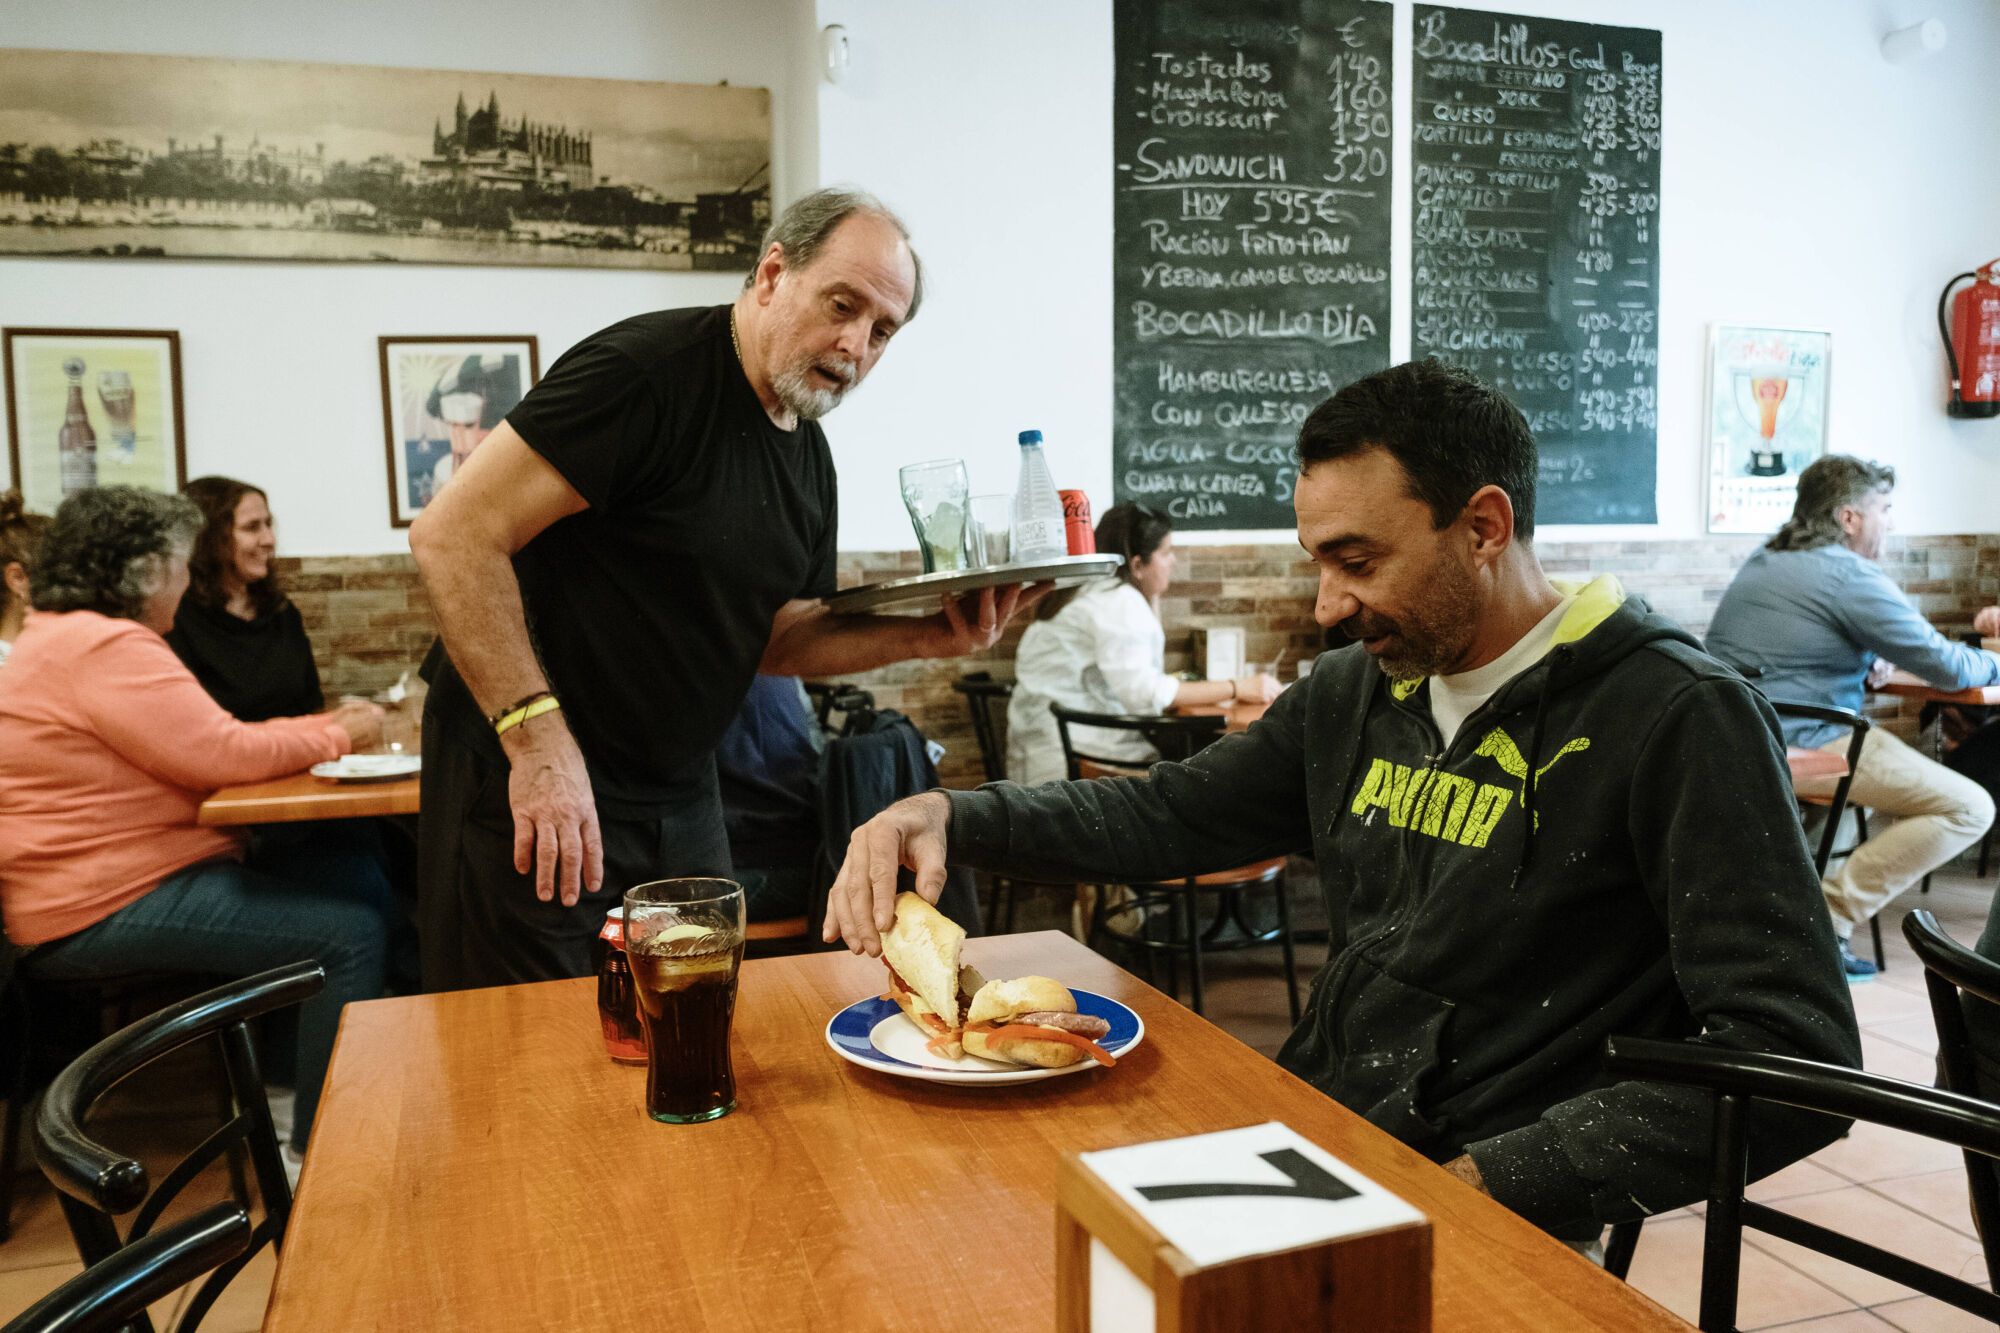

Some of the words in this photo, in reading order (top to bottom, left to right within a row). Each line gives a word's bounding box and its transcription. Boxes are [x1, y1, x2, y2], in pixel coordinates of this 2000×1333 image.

[1335, 16, 1366, 47] €
[1152, 51, 1272, 83] Tostadas
[1152, 78, 1288, 109] Magdalena
[1150, 102, 1280, 131] Croissant
[1433, 103, 1496, 125] QUESO
[1413, 124, 1494, 145] TORTILLA
[1133, 137, 1286, 183] SANDWICH
[1182, 189, 1230, 216] HOY
[1132, 300, 1314, 339] BOCADILLO
[1158, 360, 1336, 394] HAMBURGUESA
[1151, 400, 1202, 427] CON
[1214, 400, 1308, 428] QUESO
[1168, 493, 1228, 518] CAÑA
[1351, 757, 1514, 849] PUMA
[1132, 1147, 1364, 1202] 7
